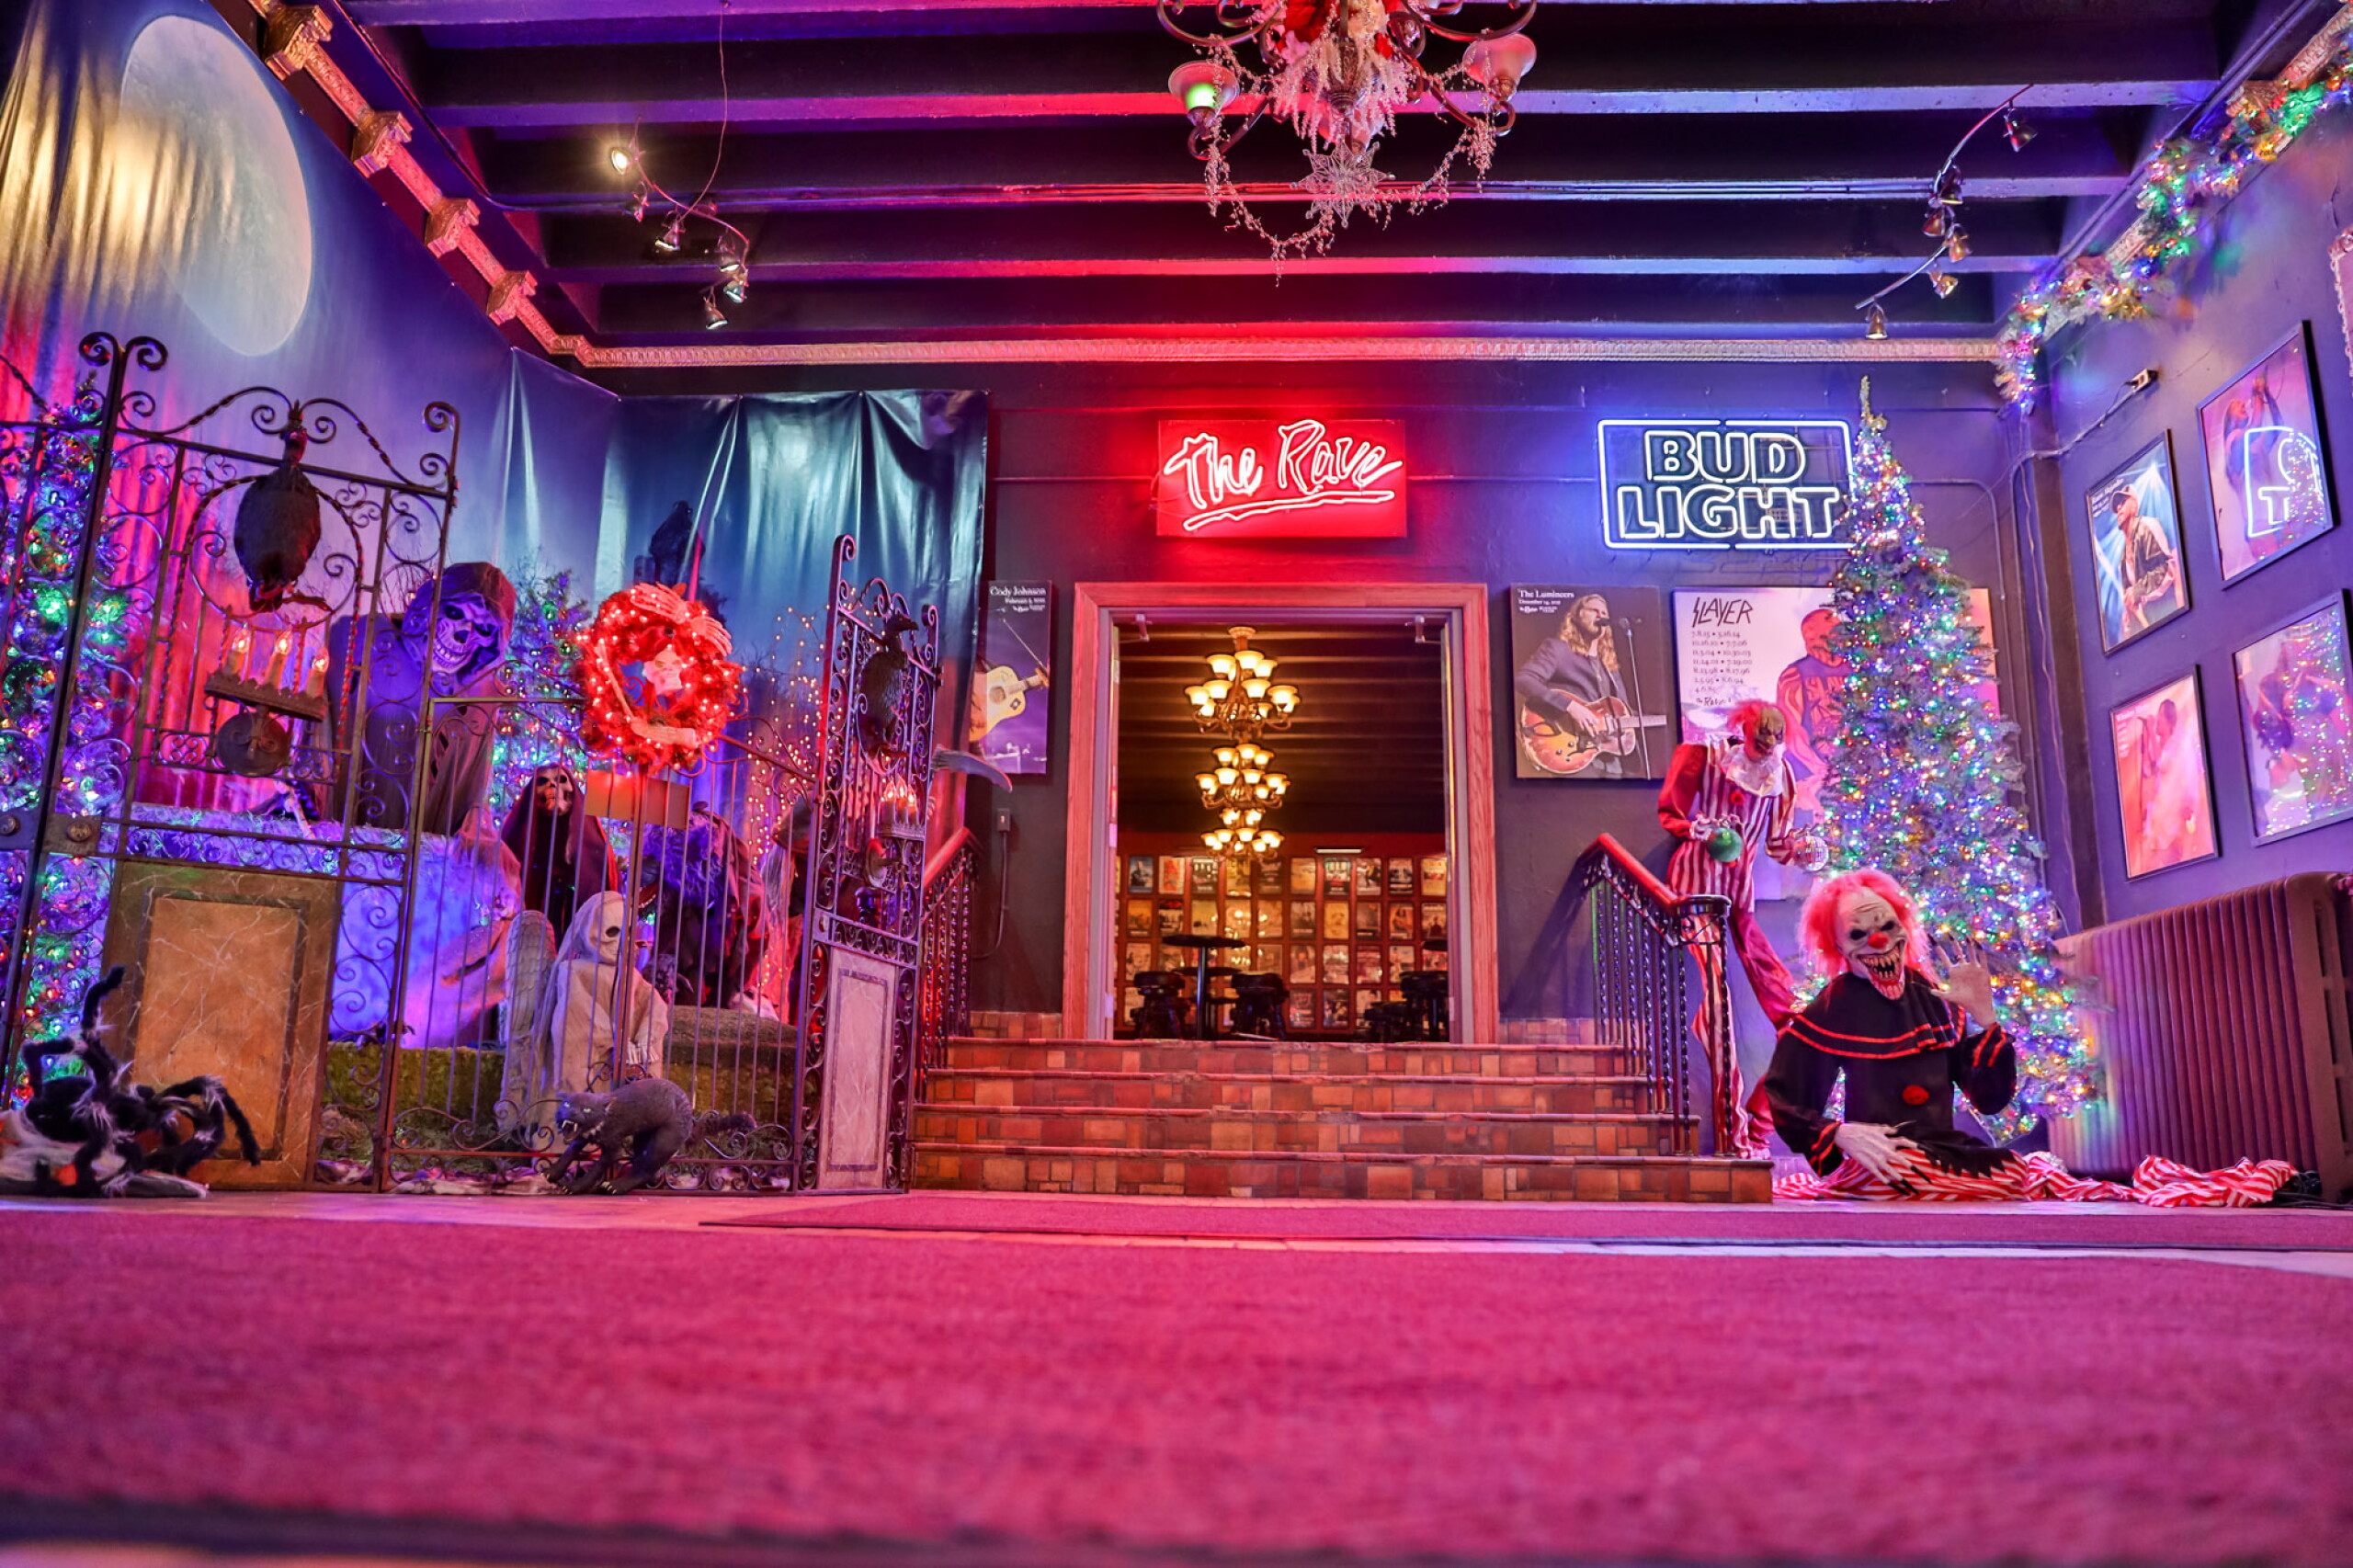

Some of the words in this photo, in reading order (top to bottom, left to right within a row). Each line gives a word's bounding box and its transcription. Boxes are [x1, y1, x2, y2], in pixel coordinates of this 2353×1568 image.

[1164, 432, 1263, 509] The
[1278, 419, 1403, 495] Rave
[1643, 430, 1806, 484] BUD
[1617, 483, 1840, 540] LIGHT
[990, 585, 1012, 597] Cody
[1013, 585, 1047, 597] Johnson
[1518, 588, 1535, 597] The
[1535, 589, 1574, 598] Lumineers
[1691, 597, 1754, 628] SLAYER
